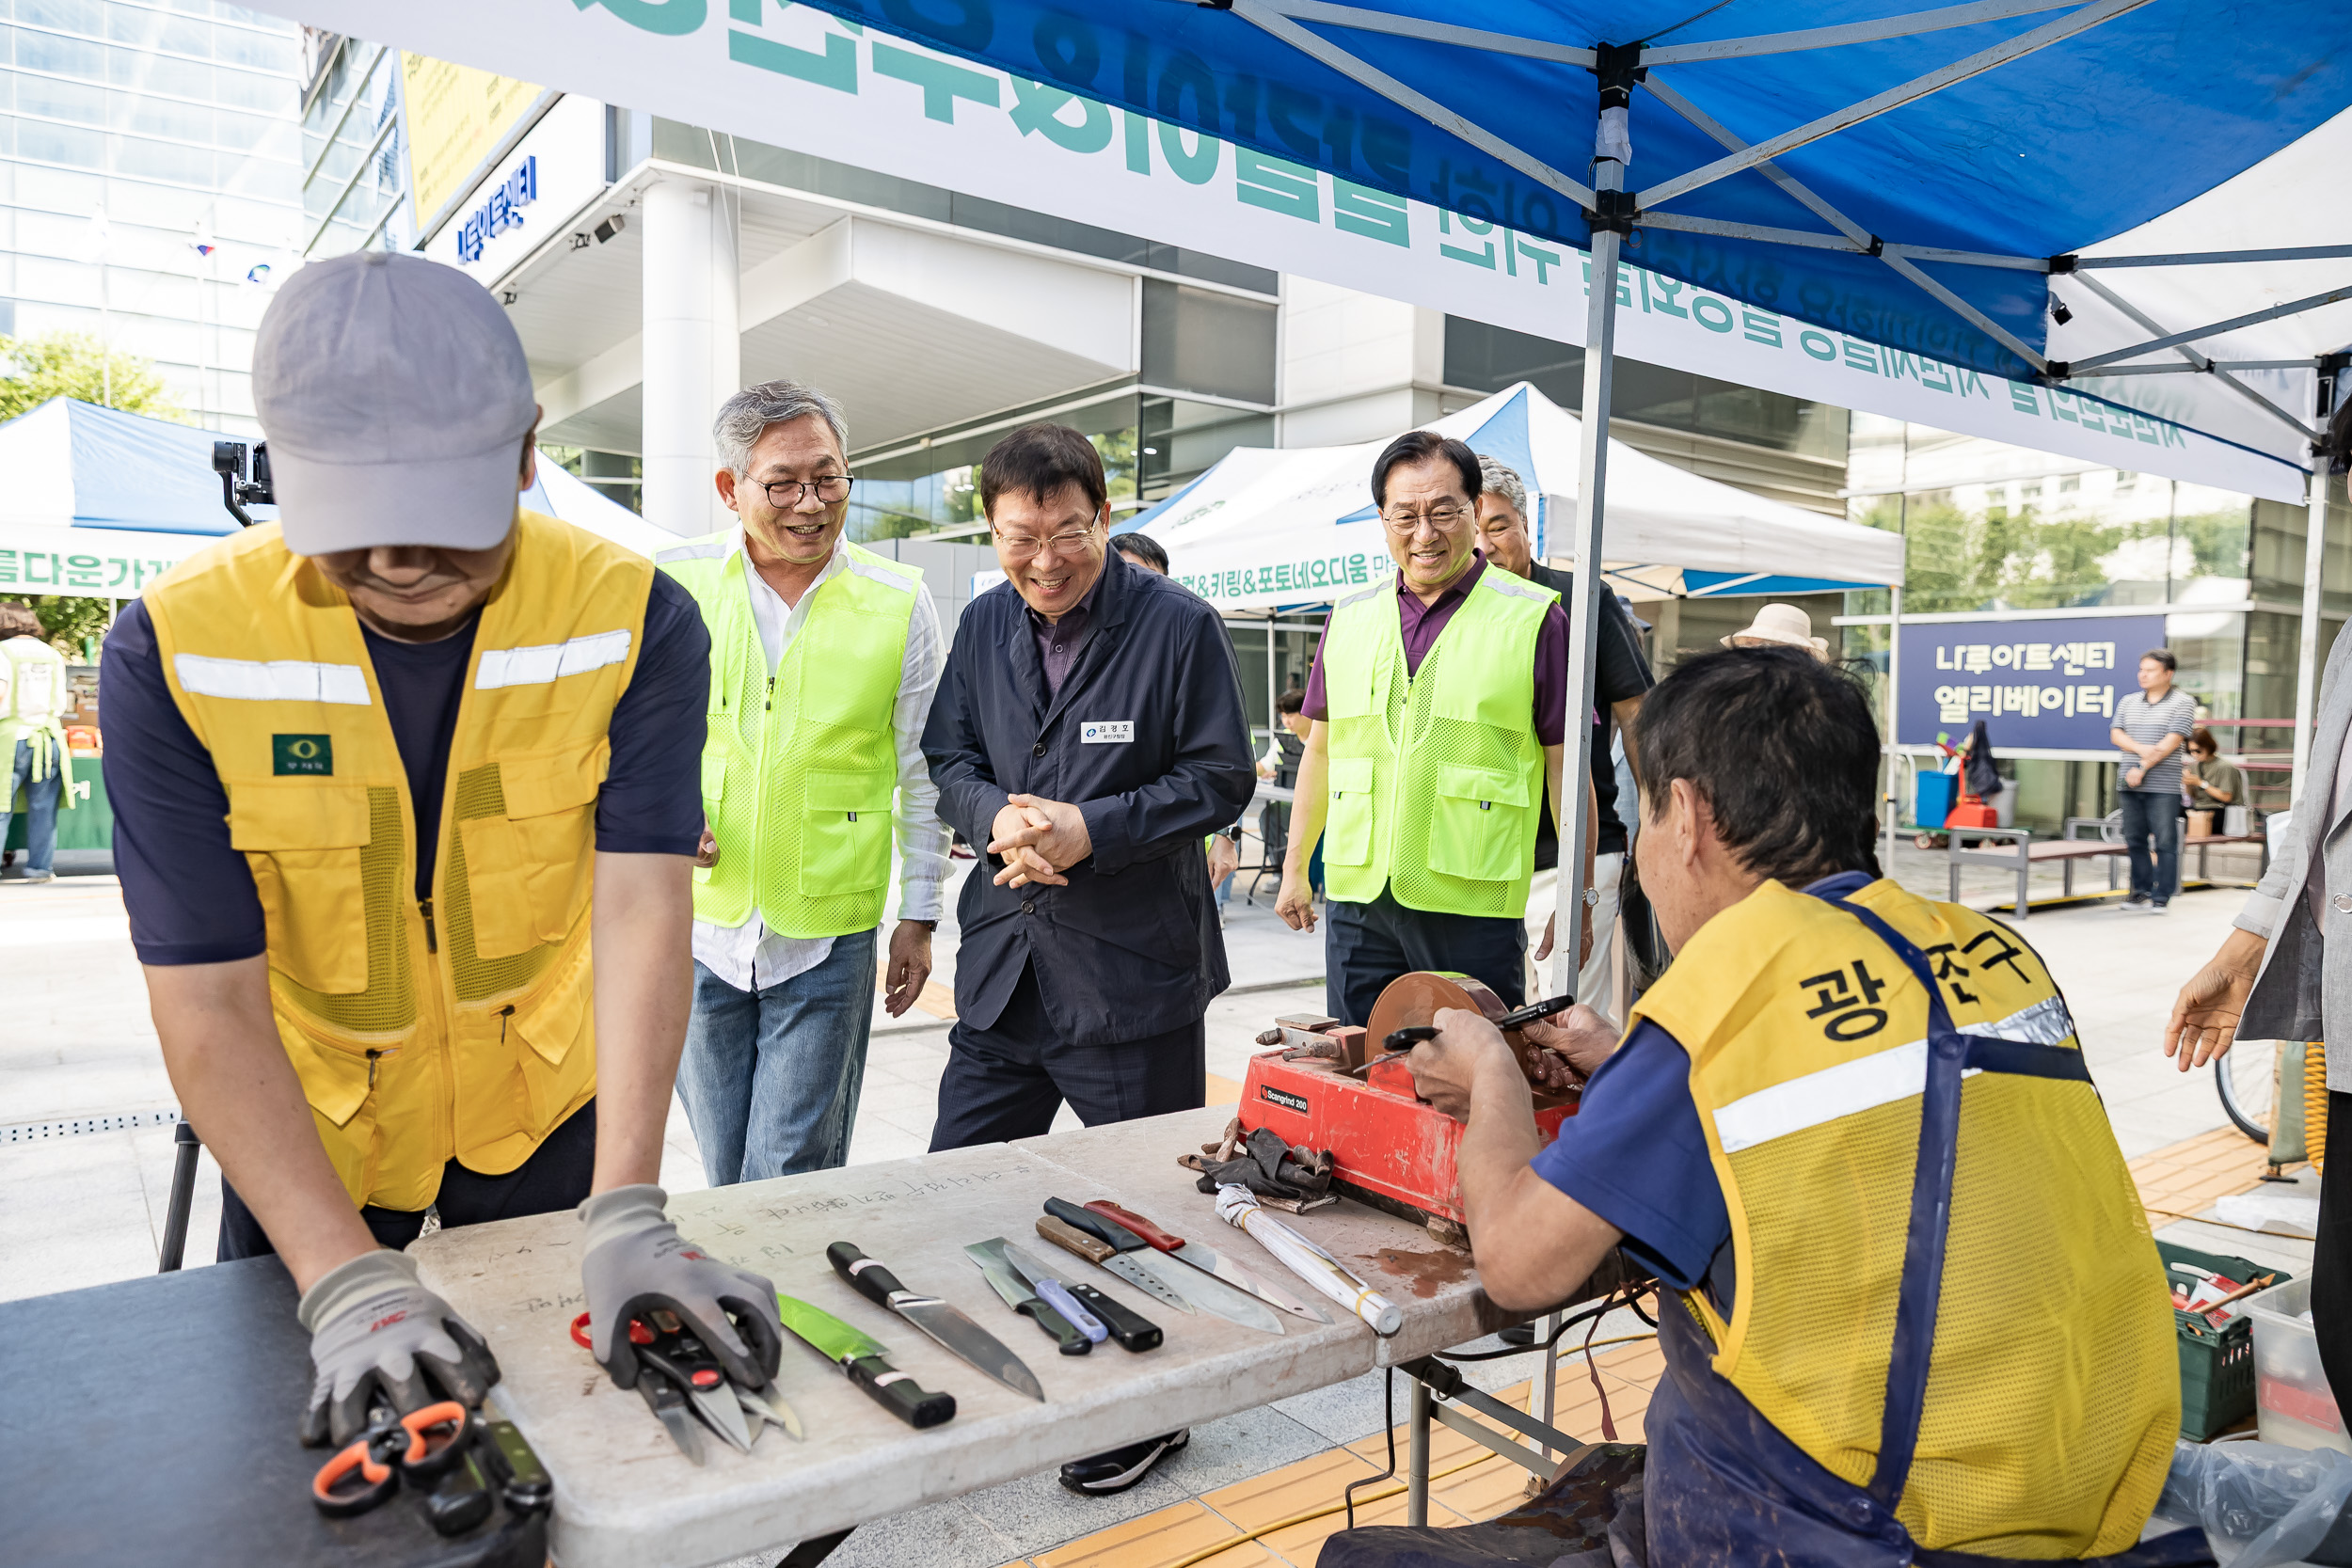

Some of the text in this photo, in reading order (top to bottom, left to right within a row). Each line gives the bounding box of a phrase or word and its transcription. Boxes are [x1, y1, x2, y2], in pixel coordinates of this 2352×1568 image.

[1173, 553, 1369, 599] &키링&포토네오디움
[1935, 641, 2116, 676] 나루아트센터
[1933, 685, 2115, 724] 엘리베이터
[1267, 1089, 1307, 1111] Scangrind 200
